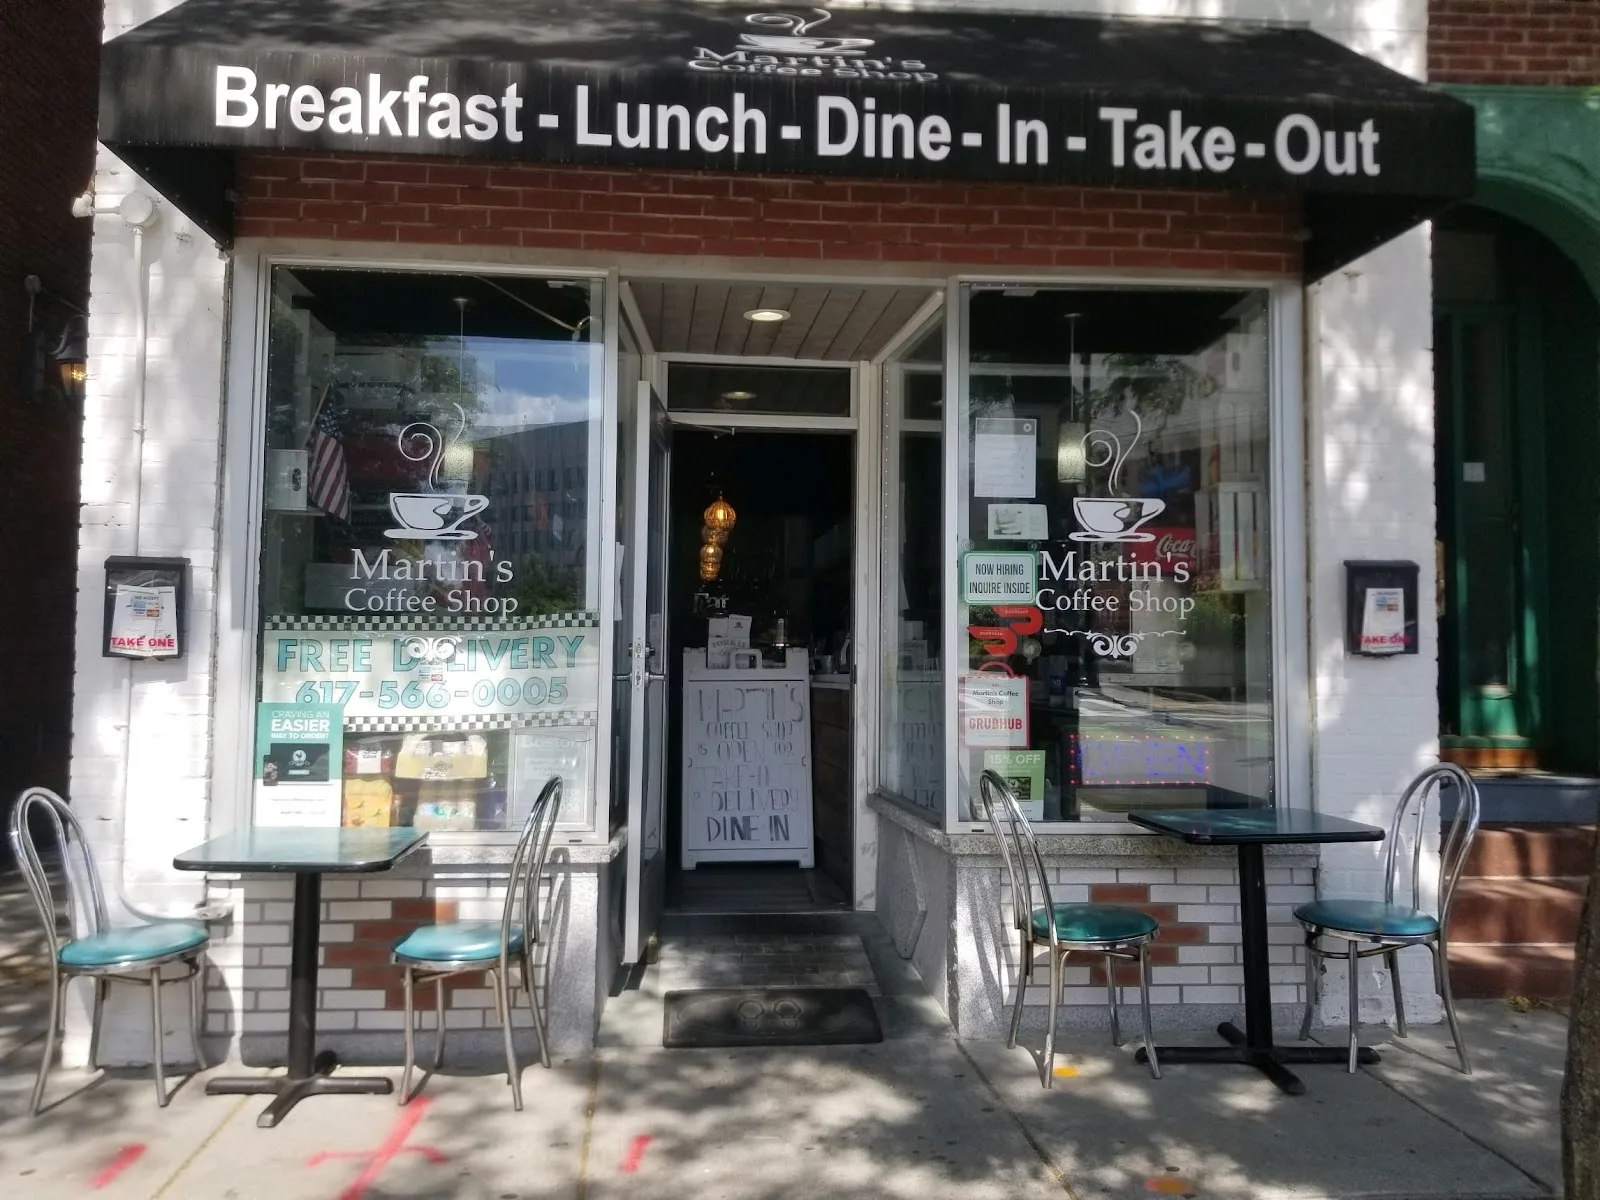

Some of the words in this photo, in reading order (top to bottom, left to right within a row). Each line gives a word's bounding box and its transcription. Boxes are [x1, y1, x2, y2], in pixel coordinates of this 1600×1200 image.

[694, 47, 926, 70] Martin's
[688, 60, 822, 76] Coffee
[833, 67, 938, 82] Shop
[214, 65, 524, 142] Breakfast
[576, 85, 767, 154] Lunch
[816, 96, 952, 161] Dine
[998, 103, 1049, 165] In
[1099, 107, 1236, 171] Take
[1274, 113, 1381, 176] Out
[350, 548, 515, 583] Martin's
[975, 564, 995, 575] NOW
[997, 564, 1024, 576] HIRING
[1038, 550, 1191, 583] Martin's
[969, 582, 1001, 594] INQUIRE
[1003, 583, 1030, 594] INSIDE
[344, 587, 437, 613] Coffee
[447, 589, 519, 620] Shop
[1035, 588, 1120, 612] Coffee
[1129, 590, 1195, 620] Shop
[109, 637, 144, 647] TAKE
[148, 638, 175, 648] ONE
[277, 638, 373, 672] FREE
[392, 635, 585, 672] DLIVERY
[295, 676, 569, 709] 617-566-0005
[988, 698, 1004, 706] Shop
[271, 711, 313, 719] CRAVING
[271, 718, 330, 732] EASIER
[969, 717, 1022, 730] GRUBHUB
[1015, 754, 1041, 765] OFF
[706, 815, 760, 842] DINE
[769, 814, 790, 842] IN
